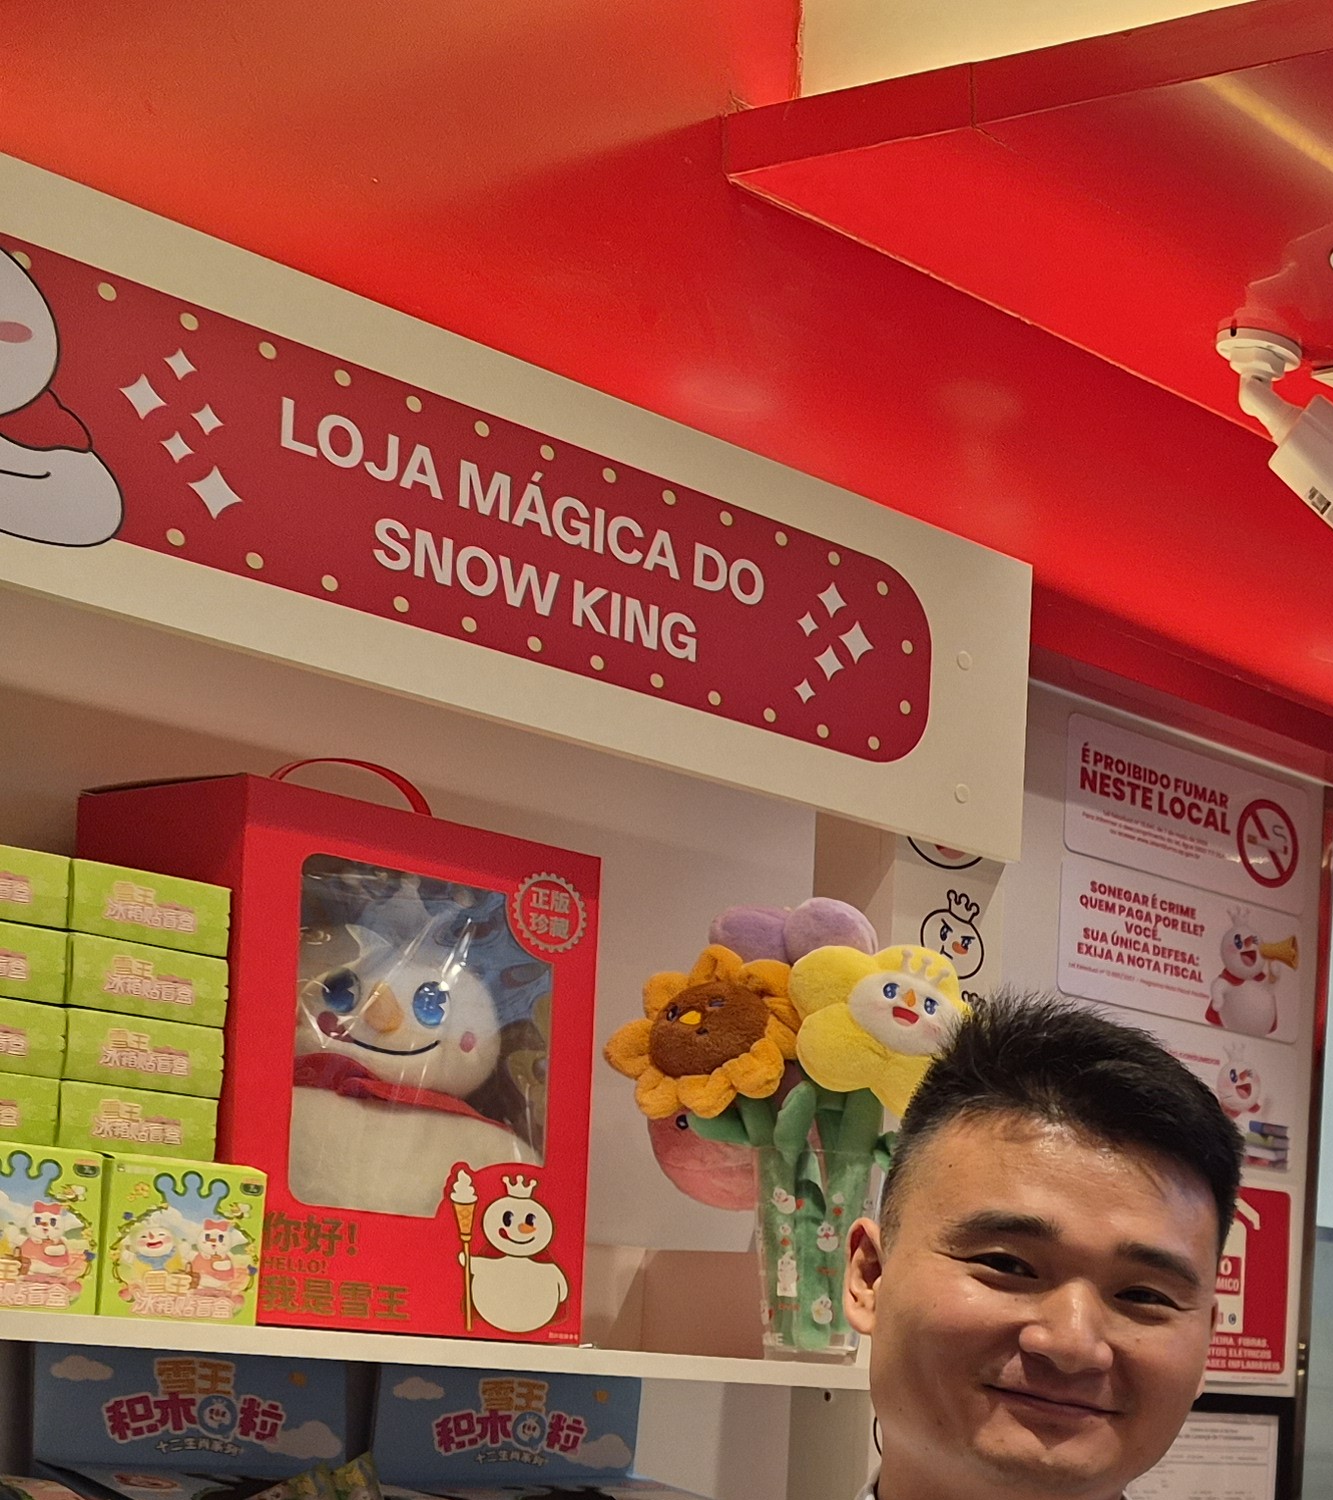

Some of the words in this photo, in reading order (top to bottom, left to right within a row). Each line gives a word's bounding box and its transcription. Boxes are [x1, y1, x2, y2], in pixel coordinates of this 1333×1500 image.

[279, 397, 444, 502] LOJA
[458, 462, 678, 583] MÁGICA
[693, 544, 764, 606] DO
[372, 516, 559, 623] SNOW
[572, 588, 698, 663] KING
[1081, 742, 1091, 765] É
[1092, 751, 1172, 791] PROIBIDO
[1173, 778, 1230, 809] FUMAR
[1079, 767, 1153, 812] NESTE
[1157, 795, 1231, 836] LOCAL
[530, 887, 570, 914] 正版
[1079, 894, 1116, 916] QUEM
[1118, 903, 1153, 926] PAGA
[1155, 912, 1180, 933] POR
[1181, 918, 1205, 938] ELE?
[1089, 880, 1150, 907] SONEGAR
[1151, 894, 1158, 910] É
[1159, 898, 1196, 920] CRIME
[1077, 941, 1112, 964] EXIJA
[1114, 951, 1125, 966] A
[1126, 954, 1161, 977] NOTA
[1162, 961, 1204, 983] FISCAL
[1082, 926, 1109, 945] SUA
[1111, 929, 1150, 957] ÚNICA
[1152, 945, 1200, 967] DEFESA:
[262, 1276, 410, 1320] 我是雪王
[155, 1358, 236, 1398] 雪王
[479, 1378, 549, 1413] 雪王
